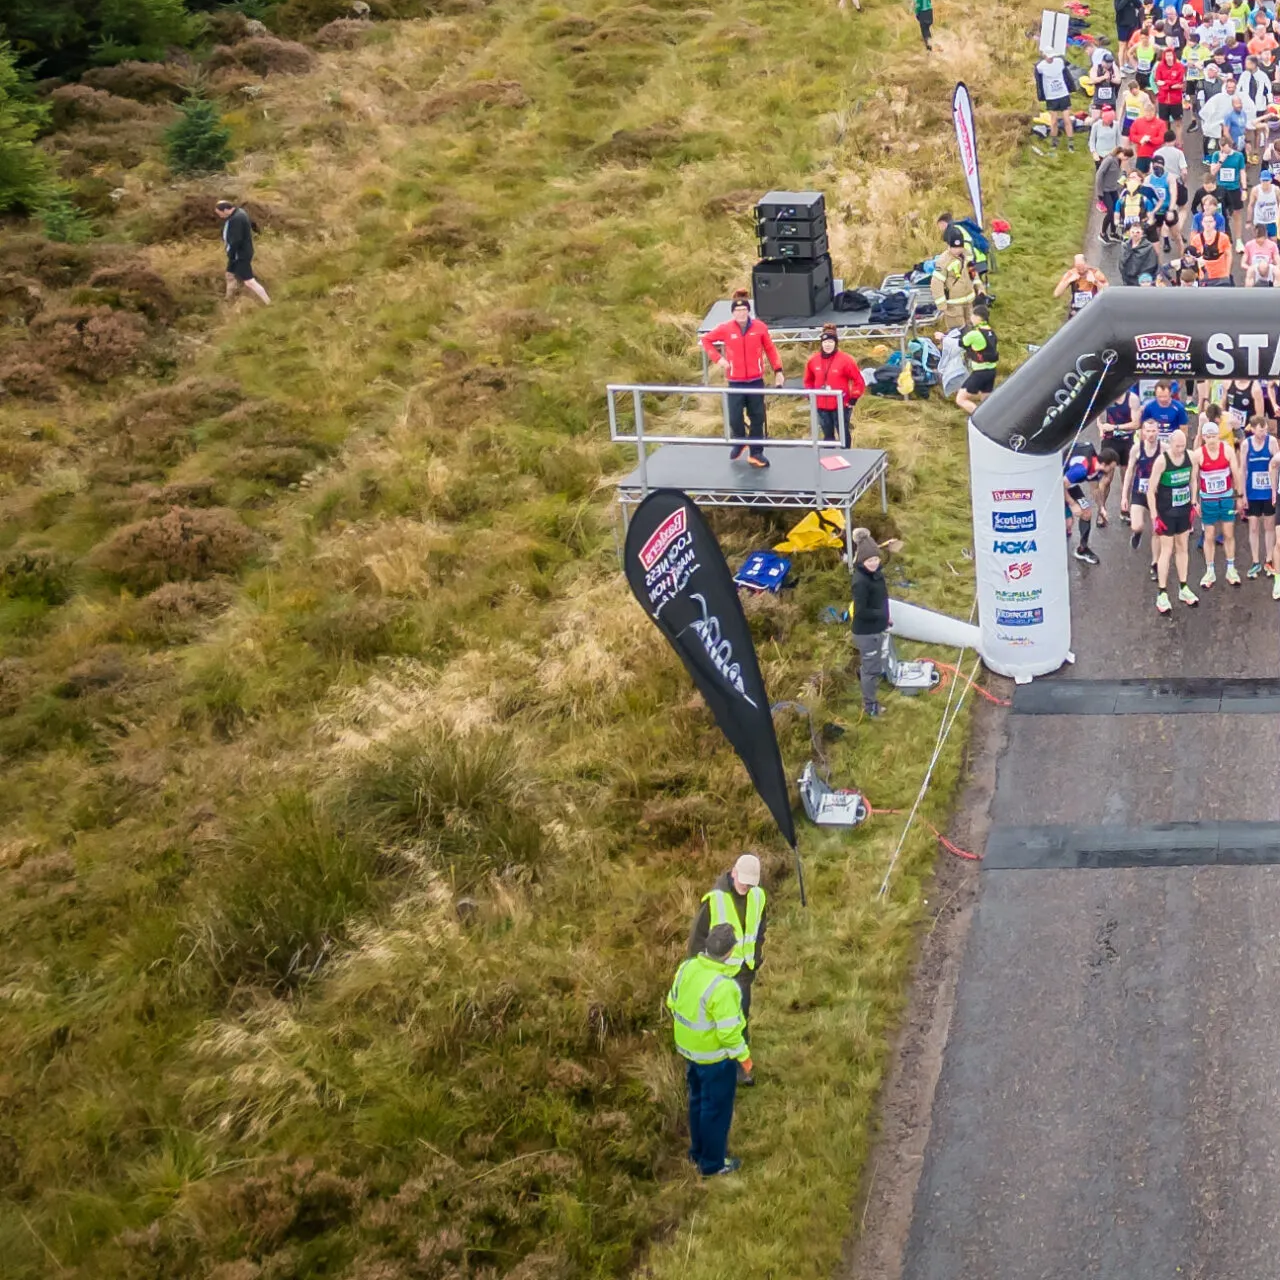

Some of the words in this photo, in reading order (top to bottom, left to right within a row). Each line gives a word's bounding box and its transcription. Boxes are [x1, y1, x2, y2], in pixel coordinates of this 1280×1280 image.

[1140, 336, 1186, 349] Baxters
[1136, 352, 1165, 361] LOCH
[1167, 352, 1191, 361] NESS
[994, 513, 1034, 524] Scotland
[993, 539, 1037, 554] HOKA
